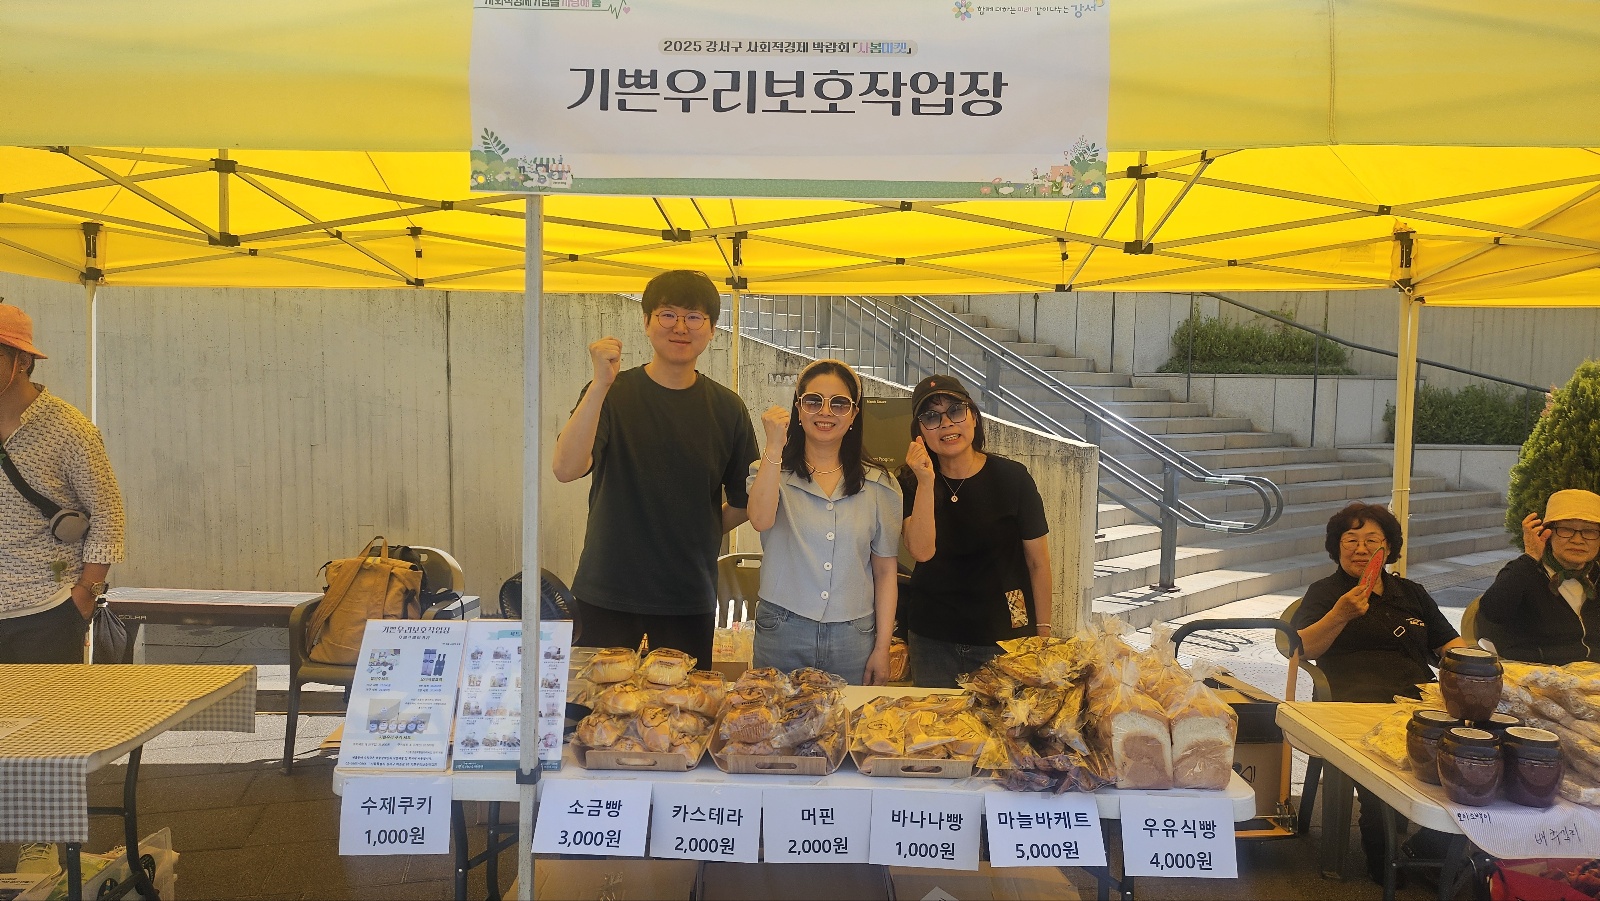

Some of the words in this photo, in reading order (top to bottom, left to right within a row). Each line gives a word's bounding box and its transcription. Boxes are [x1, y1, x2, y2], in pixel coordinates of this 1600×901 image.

[1070, 3, 1097, 19] 강서
[663, 40, 702, 52] 2025
[705, 40, 743, 53] 강서구
[746, 41, 809, 54] 사회적경제
[812, 41, 850, 54] 박람회
[566, 68, 1009, 117] 기쁜우리보호작업장
[360, 795, 432, 816] 수제쿠키
[567, 799, 623, 818] 소금빵
[671, 804, 744, 827] 카스테라
[801, 807, 835, 826] 머핀
[891, 809, 964, 832] 바나나빵
[997, 811, 1092, 830] 마늘바케트
[364, 826, 425, 847] 1,000원
[558, 829, 622, 849] 3,000원
[1142, 818, 1217, 840] 우유식빵
[674, 836, 736, 856] 2,000원
[787, 836, 849, 856] 2,000원
[895, 841, 955, 861] 1,000원
[1015, 840, 1080, 861] 5,000원
[1149, 851, 1213, 871] 4,000원
